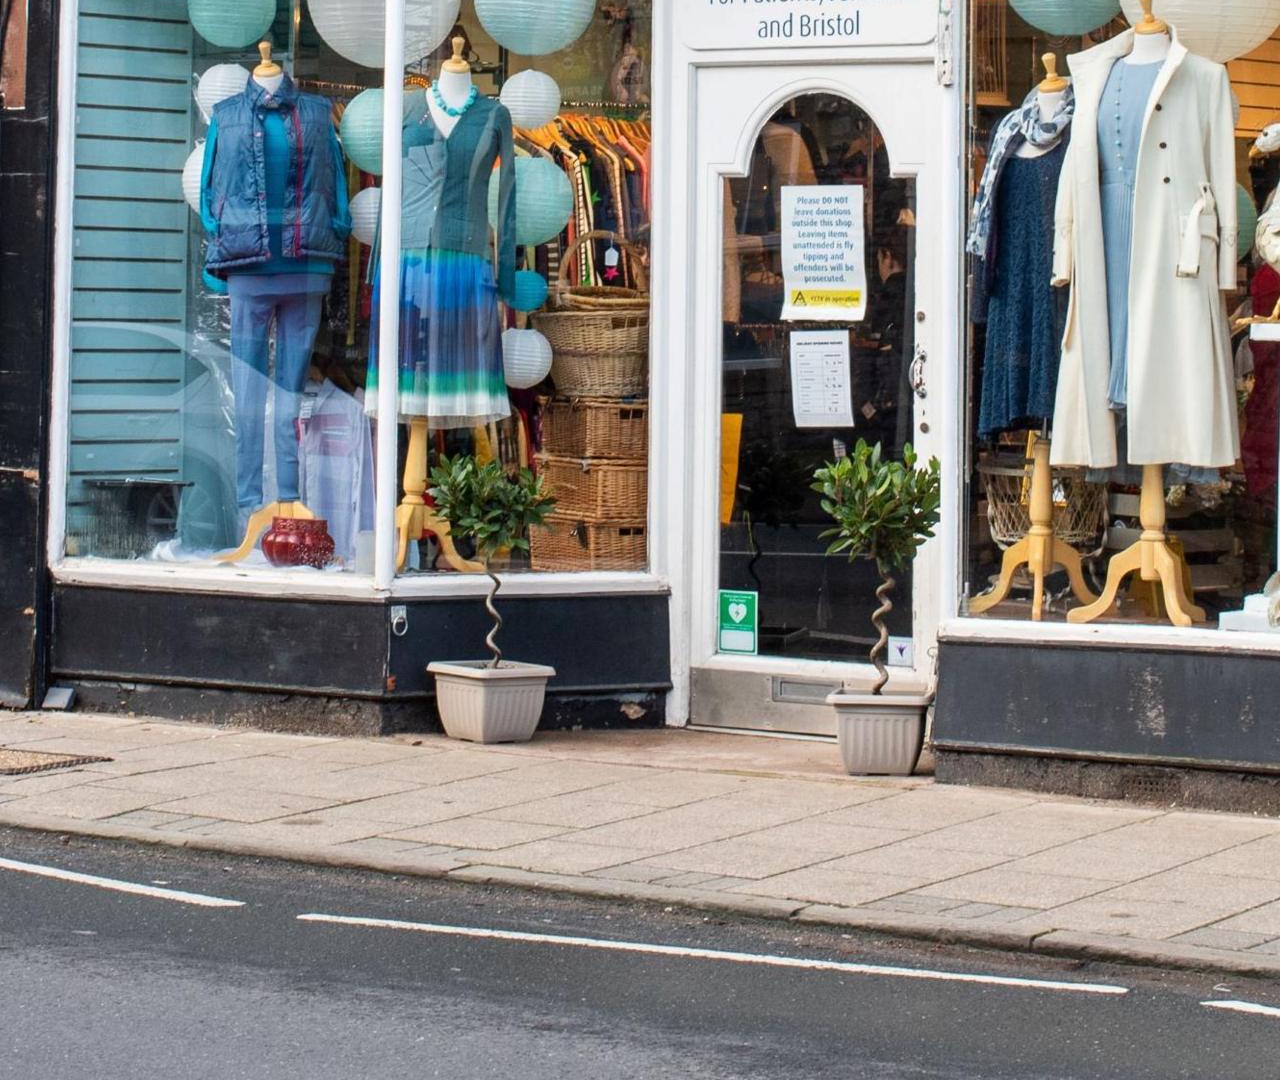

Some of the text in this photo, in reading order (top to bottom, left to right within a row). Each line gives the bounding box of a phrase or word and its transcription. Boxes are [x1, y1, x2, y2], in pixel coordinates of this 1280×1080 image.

[758, 10, 860, 38] and Bristol
[797, 196, 848, 204] Please DO NOT
[794, 208, 851, 216] leave donations
[798, 230, 848, 239] Leaving items
[793, 241, 835, 249] unattended
[844, 241, 854, 251] fly
[803, 252, 844, 262] tipping and
[793, 263, 854, 272] offenders will be
[804, 275, 847, 283] prosecuted.
